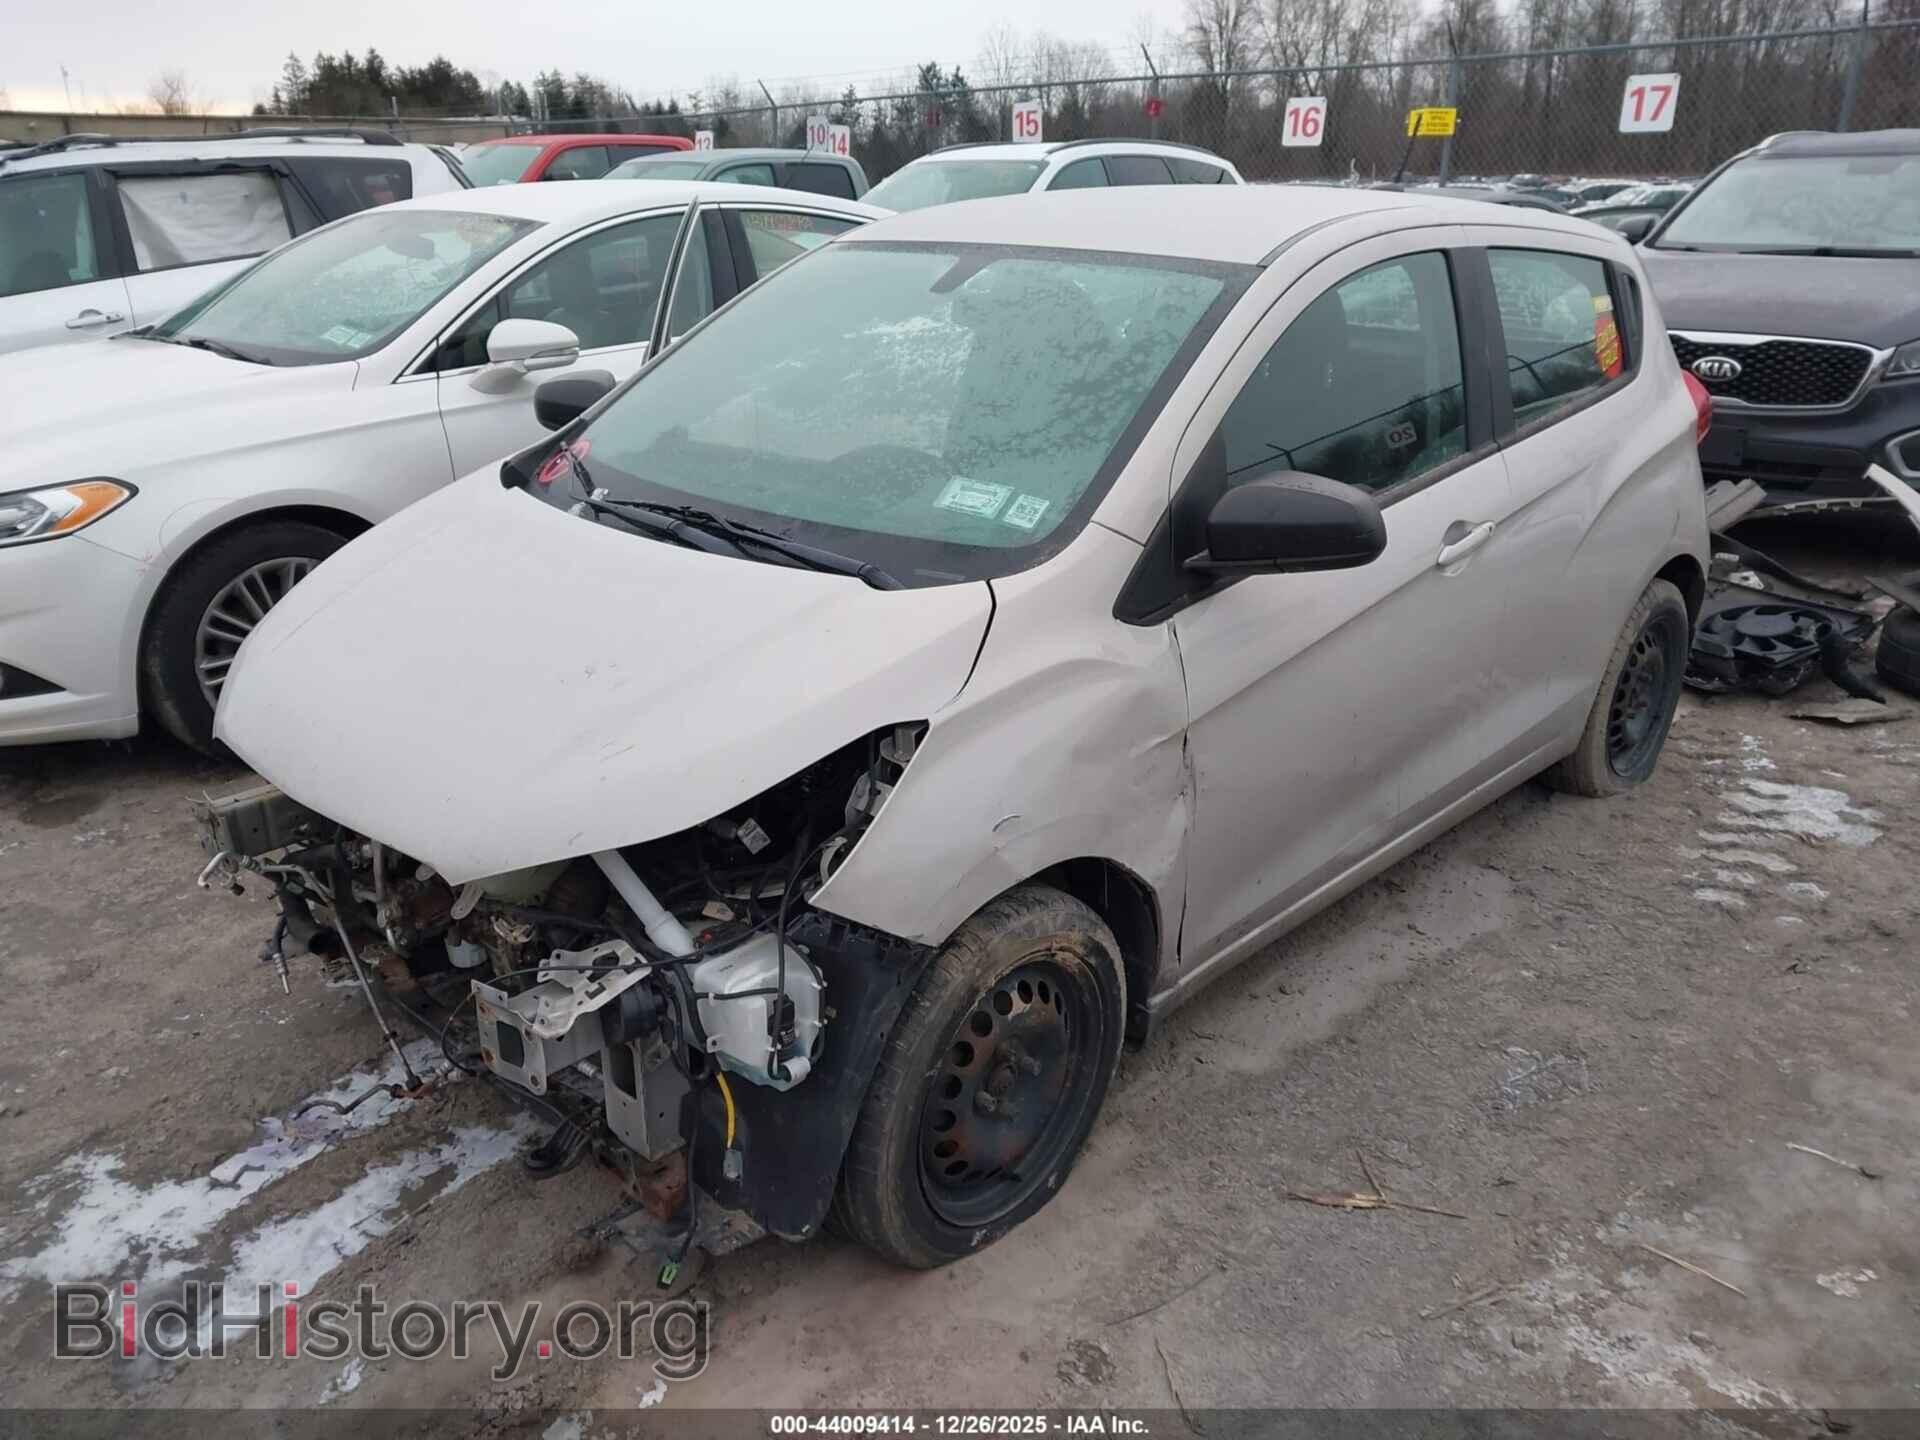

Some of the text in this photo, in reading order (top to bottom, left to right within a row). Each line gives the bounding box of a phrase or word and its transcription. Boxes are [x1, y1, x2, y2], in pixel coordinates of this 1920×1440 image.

[1630, 85, 1672, 122] 17
[808, 123, 826, 145] 10
[1014, 110, 1040, 137] 15
[1289, 106, 1321, 138] 16
[829, 131, 848, 155] 14
[1700, 361, 1732, 377] KIA
